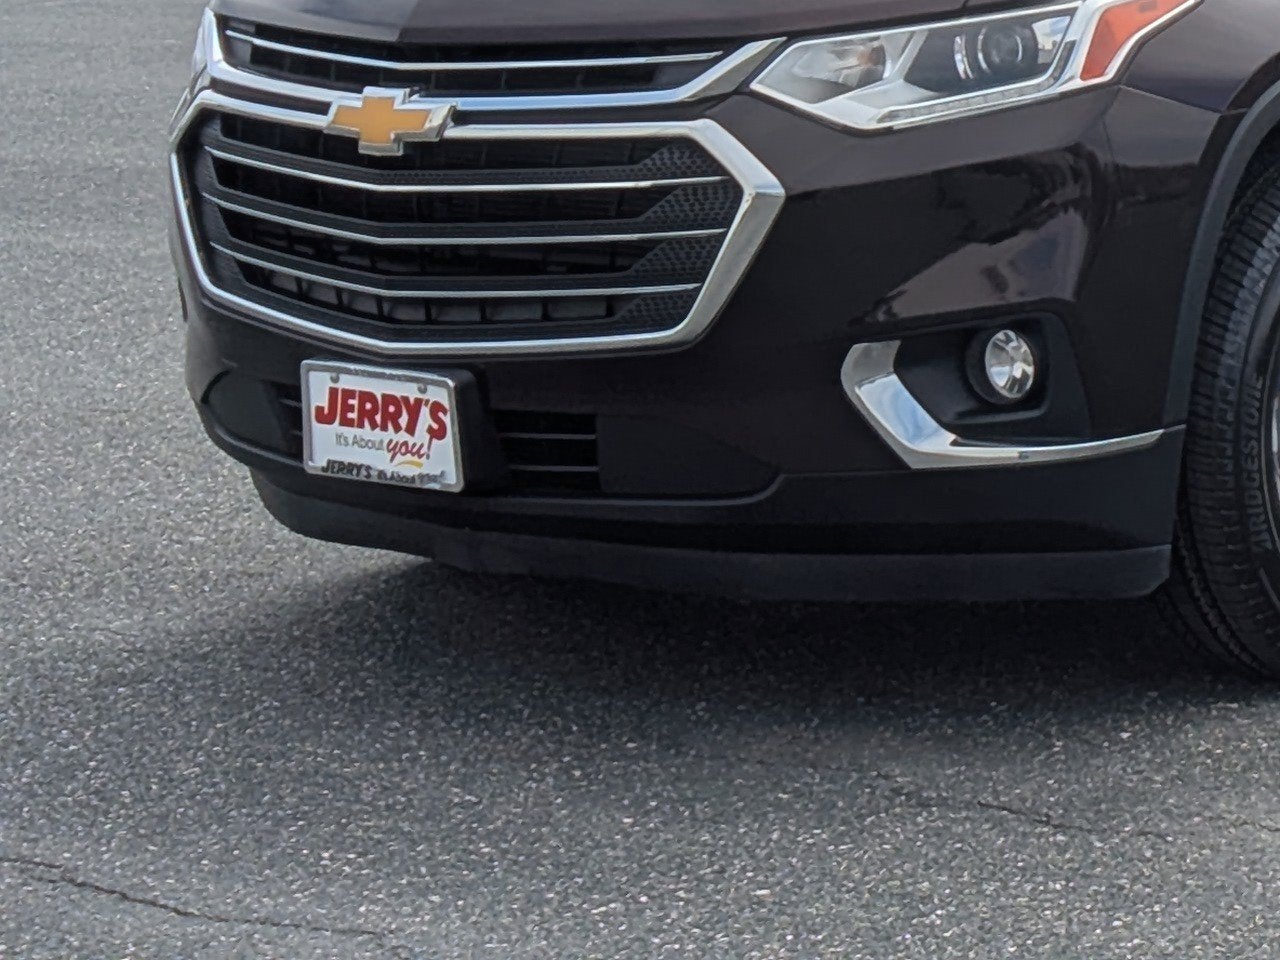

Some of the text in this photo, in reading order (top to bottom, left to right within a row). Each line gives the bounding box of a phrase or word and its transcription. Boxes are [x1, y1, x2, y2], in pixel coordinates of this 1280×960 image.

[314, 386, 450, 441] JERRY'S
[352, 434, 384, 451] About
[386, 436, 433, 464] you!
